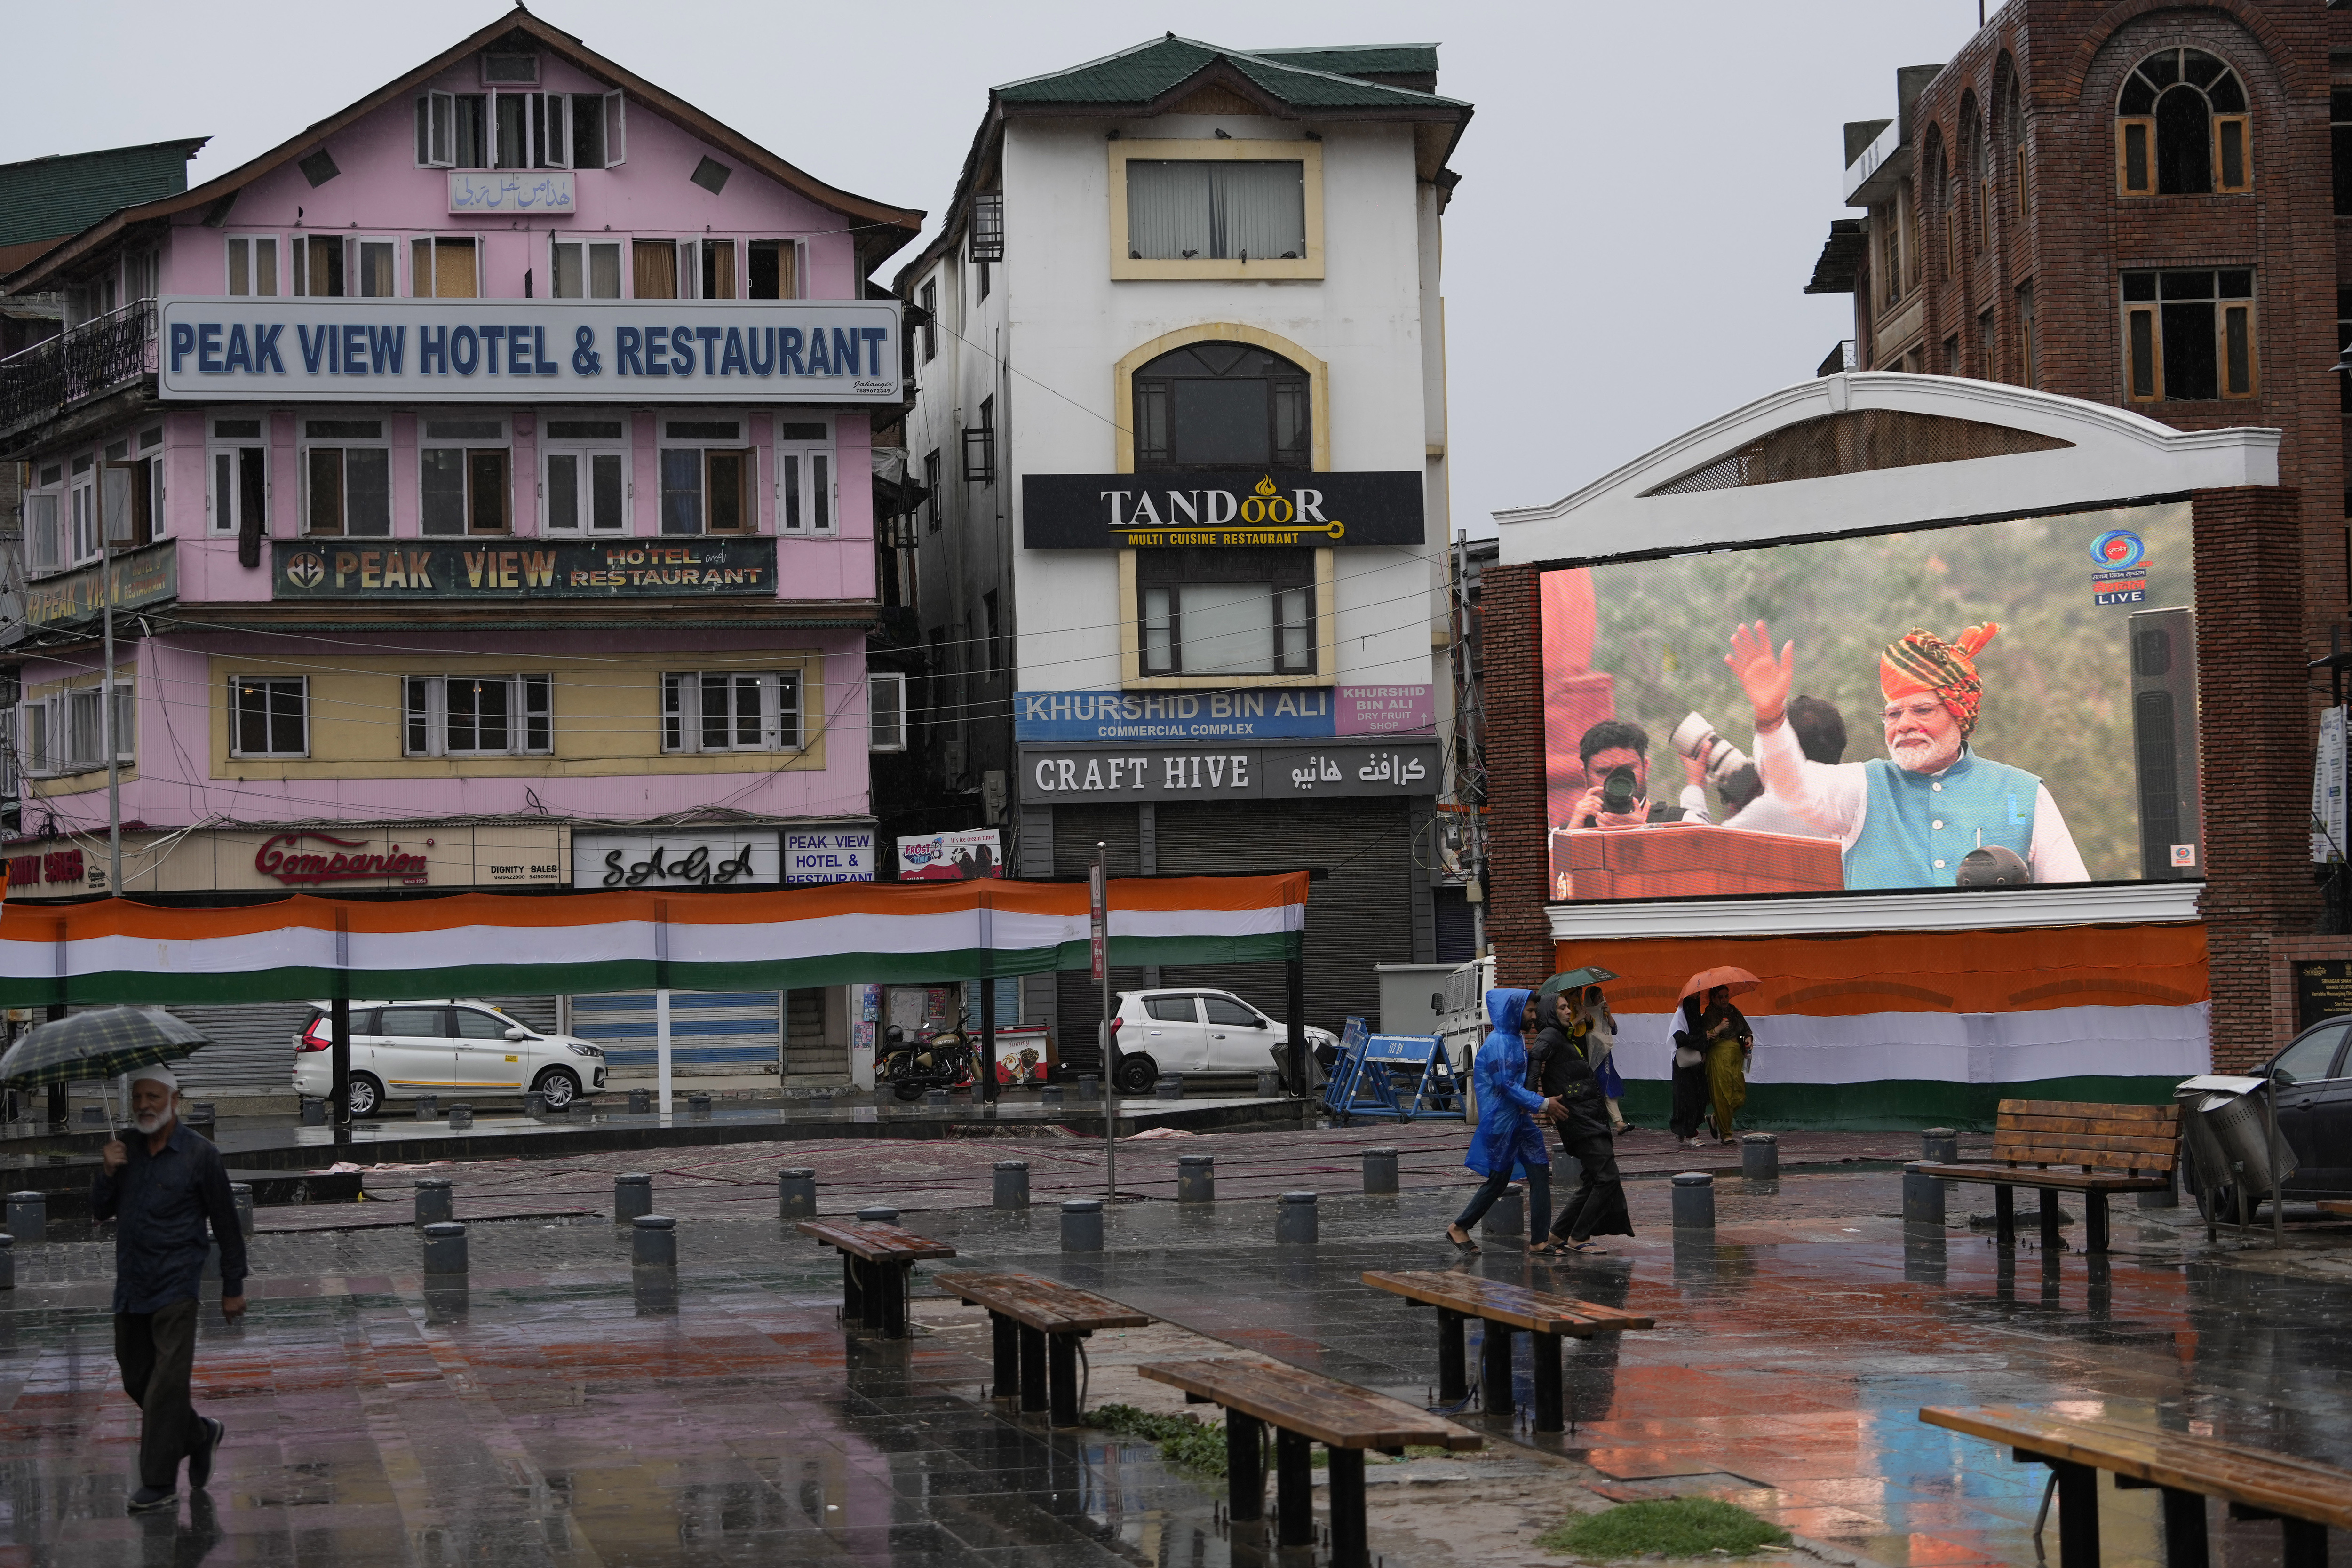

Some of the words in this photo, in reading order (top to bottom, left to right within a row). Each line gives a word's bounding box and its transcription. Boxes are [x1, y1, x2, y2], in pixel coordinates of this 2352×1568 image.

[171, 323, 285, 373] PEAK
[297, 324, 405, 374] VIEW
[420, 325, 558, 375] HOTEL
[572, 326, 602, 375] &
[616, 326, 887, 376] RESTAURANT
[853, 380, 892, 389] Jahangir
[1101, 489, 1328, 525] TANDOOR
[1128, 533, 1163, 545] MULTI
[1170, 533, 1216, 545] CUISINE
[1224, 533, 1299, 545] RESTAURANT
[606, 549, 702, 565] HOTEL
[706, 549, 726, 564] and
[336, 551, 434, 589] PEAK
[463, 550, 557, 588] VIEW
[570, 568, 763, 587] RESTAURANT
[125, 573, 167, 600] RESTAURANT
[42, 581, 77, 622] PEAK
[2098, 591, 2142, 604] LIVE
[1343, 687, 1425, 698] KHURSHID
[1027, 693, 1199, 720] KHURSHID
[1211, 692, 1264, 718] BIN
[1274, 691, 1326, 716] ALI
[1357, 700, 1383, 710] BIN
[1388, 700, 1413, 709] ALI
[1098, 725, 1186, 737] COMMERCIAL
[1191, 724, 1254, 735] COMPLEX
[1035, 757, 1148, 791] CRAFT
[1164, 755, 1249, 789] HIVE
[789, 836, 828, 849] PEAK
[835, 835, 870, 848] VIEW
[255, 832, 428, 885] Companion
[796, 855, 842, 868] HOTEL
[849, 854, 858, 867] &
[1008, 1039, 1032, 1048] Yummy
[1388, 1043, 1397, 1054] 132
[1396, 1043, 1404, 1054] BN
